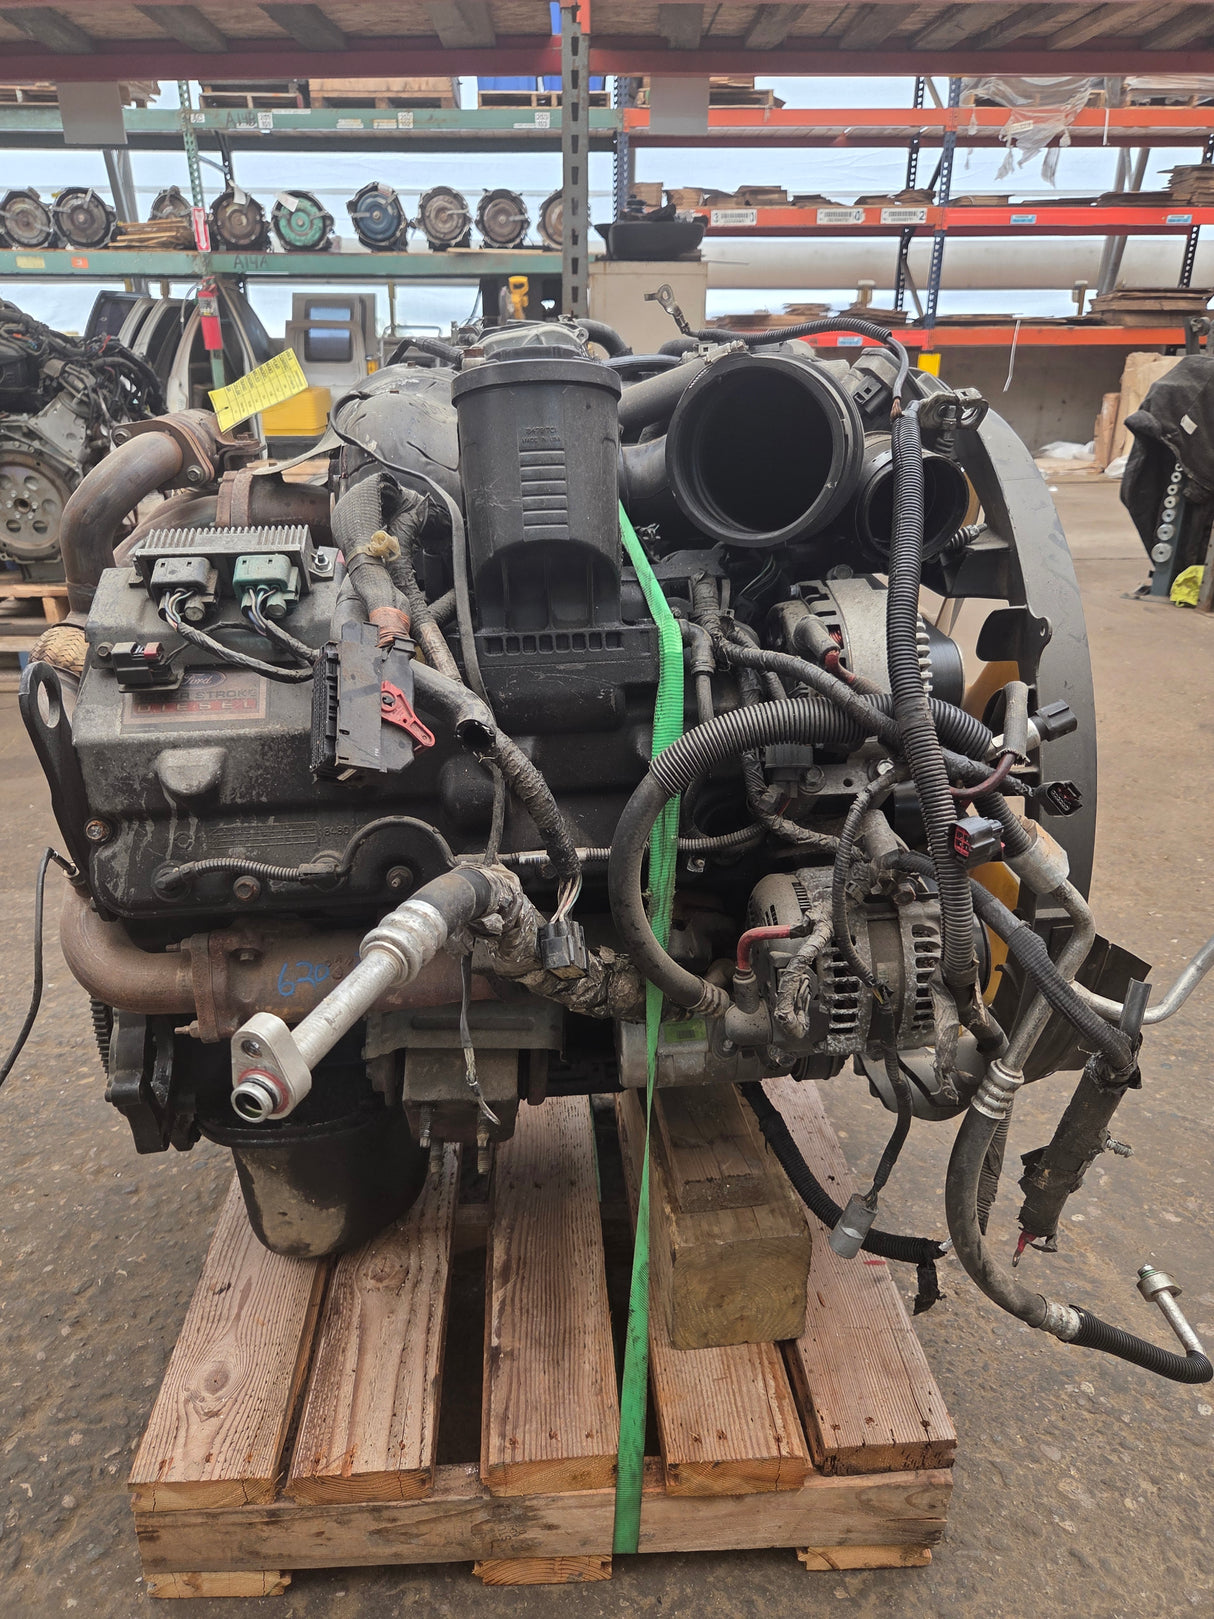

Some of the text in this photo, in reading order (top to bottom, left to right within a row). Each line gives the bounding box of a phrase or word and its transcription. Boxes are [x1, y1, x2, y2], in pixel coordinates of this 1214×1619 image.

[234, 255, 270, 269] A14A
[184, 673, 213, 685] Ford
[196, 688, 258, 699] STROKE
[138, 699, 255, 713] DIESEL
[278, 961, 330, 997] 620
